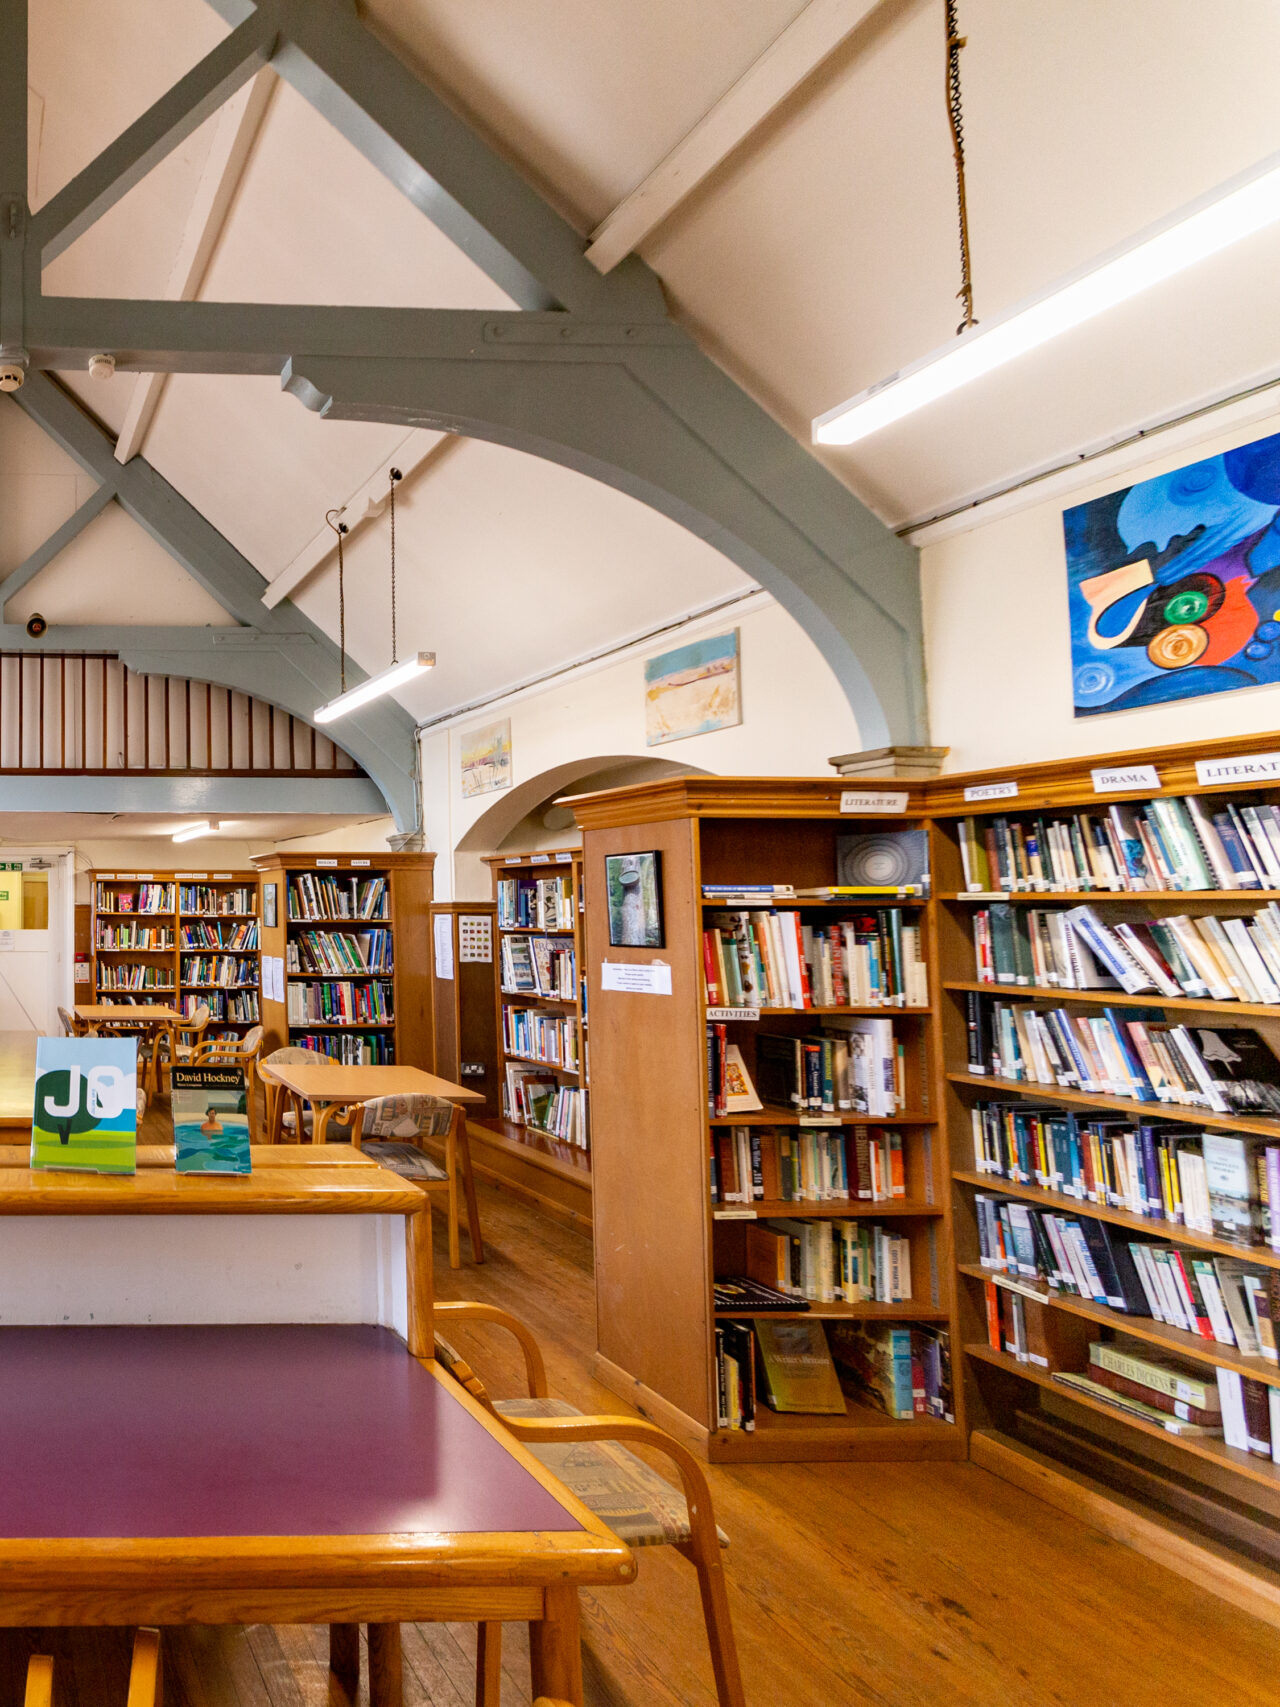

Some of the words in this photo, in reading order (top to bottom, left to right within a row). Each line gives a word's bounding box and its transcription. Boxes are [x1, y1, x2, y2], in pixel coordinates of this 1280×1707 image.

[1100, 773, 1148, 785] DRAMA
[970, 785, 1013, 798] POETRY
[845, 798, 898, 806] LITERATURE
[708, 1009, 758, 1018] ACTIVITIES
[175, 1072, 202, 1082] David
[203, 1072, 240, 1085] Hockney
[856, 1125, 871, 1190] HEMINGWAY
[1102, 1351, 1135, 1378] CHARLES
[1135, 1366, 1170, 1390] DICKENS
